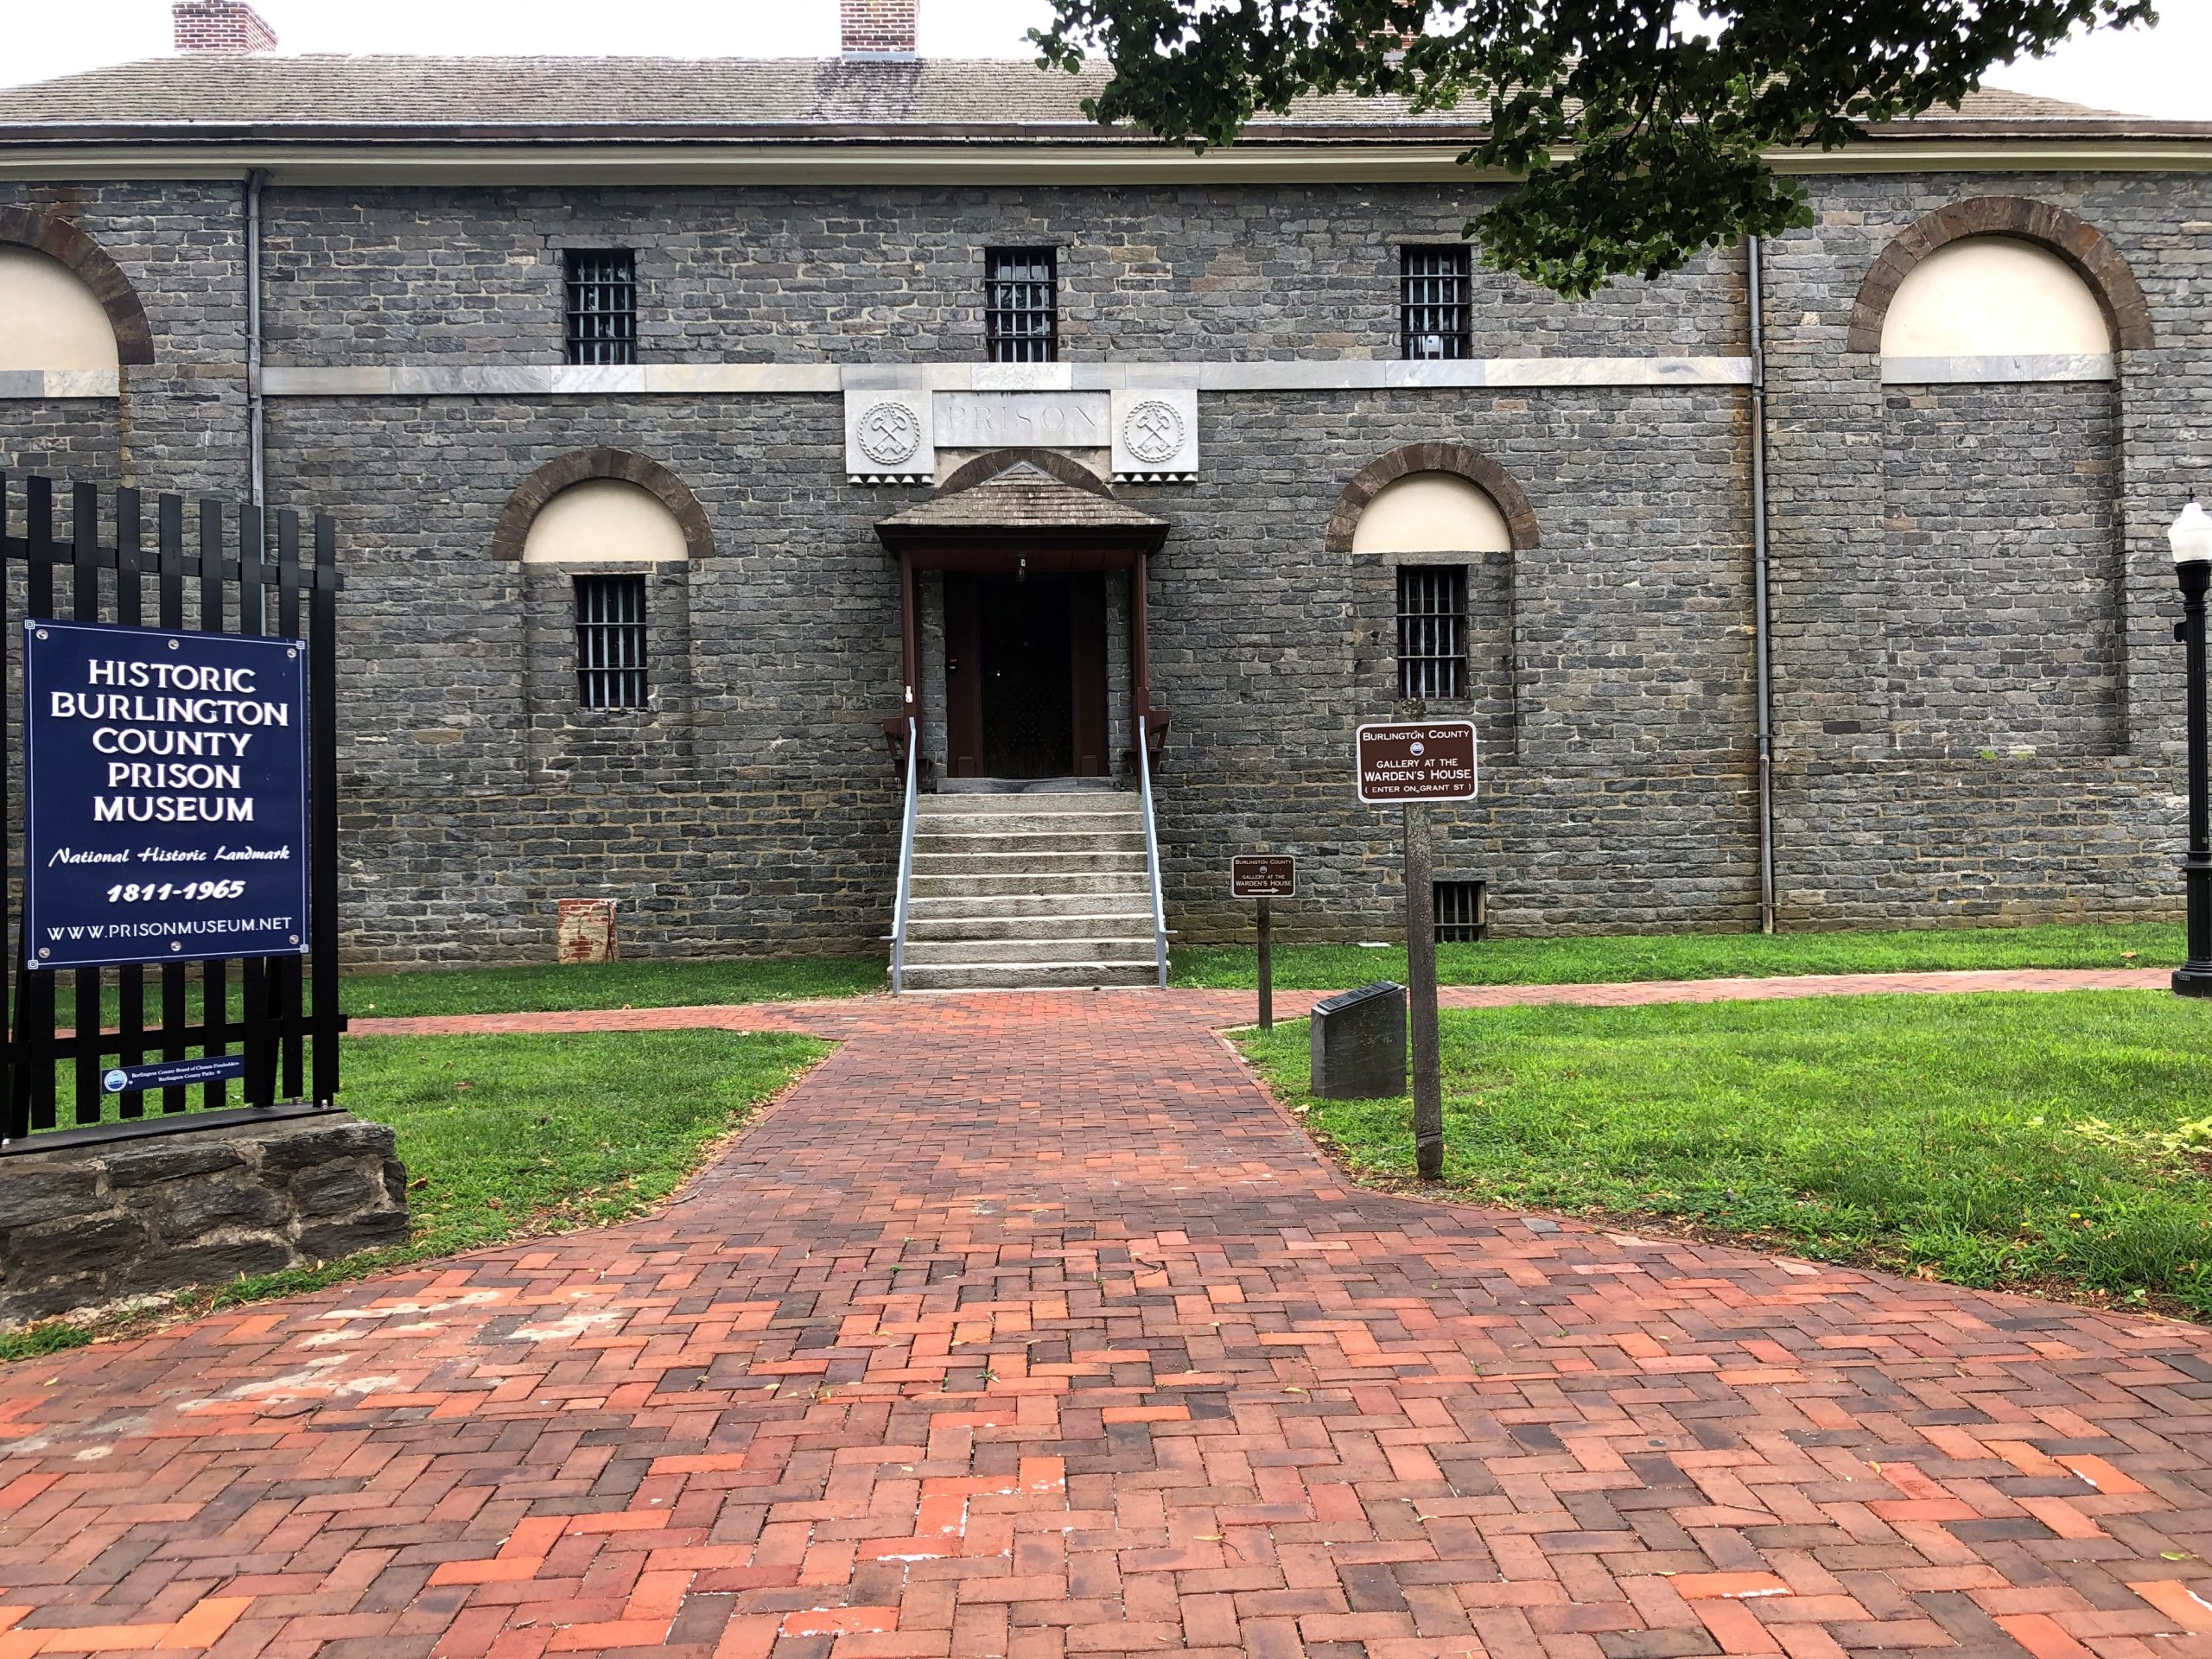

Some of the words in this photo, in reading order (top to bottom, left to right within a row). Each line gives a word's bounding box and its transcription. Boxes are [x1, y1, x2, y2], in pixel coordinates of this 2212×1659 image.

[947, 406, 1096, 431] PRISON
[88, 659, 257, 693] HISTORIC
[50, 691, 289, 727] BURLINGTON
[92, 728, 253, 757] COUNTY
[1363, 732, 1424, 741] BURLINGTON
[1428, 730, 1470, 739] COUNTY
[1376, 760, 1420, 768] GALLERY
[1439, 758, 1459, 766] THE
[107, 762, 241, 789] PRISON
[1364, 771, 1425, 782] WARDEN'S
[1431, 769, 1471, 779] HOUSE
[93, 796, 254, 822] MUSEUM
[48, 848, 130, 867] National
[137, 847, 207, 862] Historic
[213, 845, 290, 861] Landmark
[106, 879, 246, 903] 1811-1965
[47, 917, 292, 940] WWW.PRISONMUSEUM.NET
